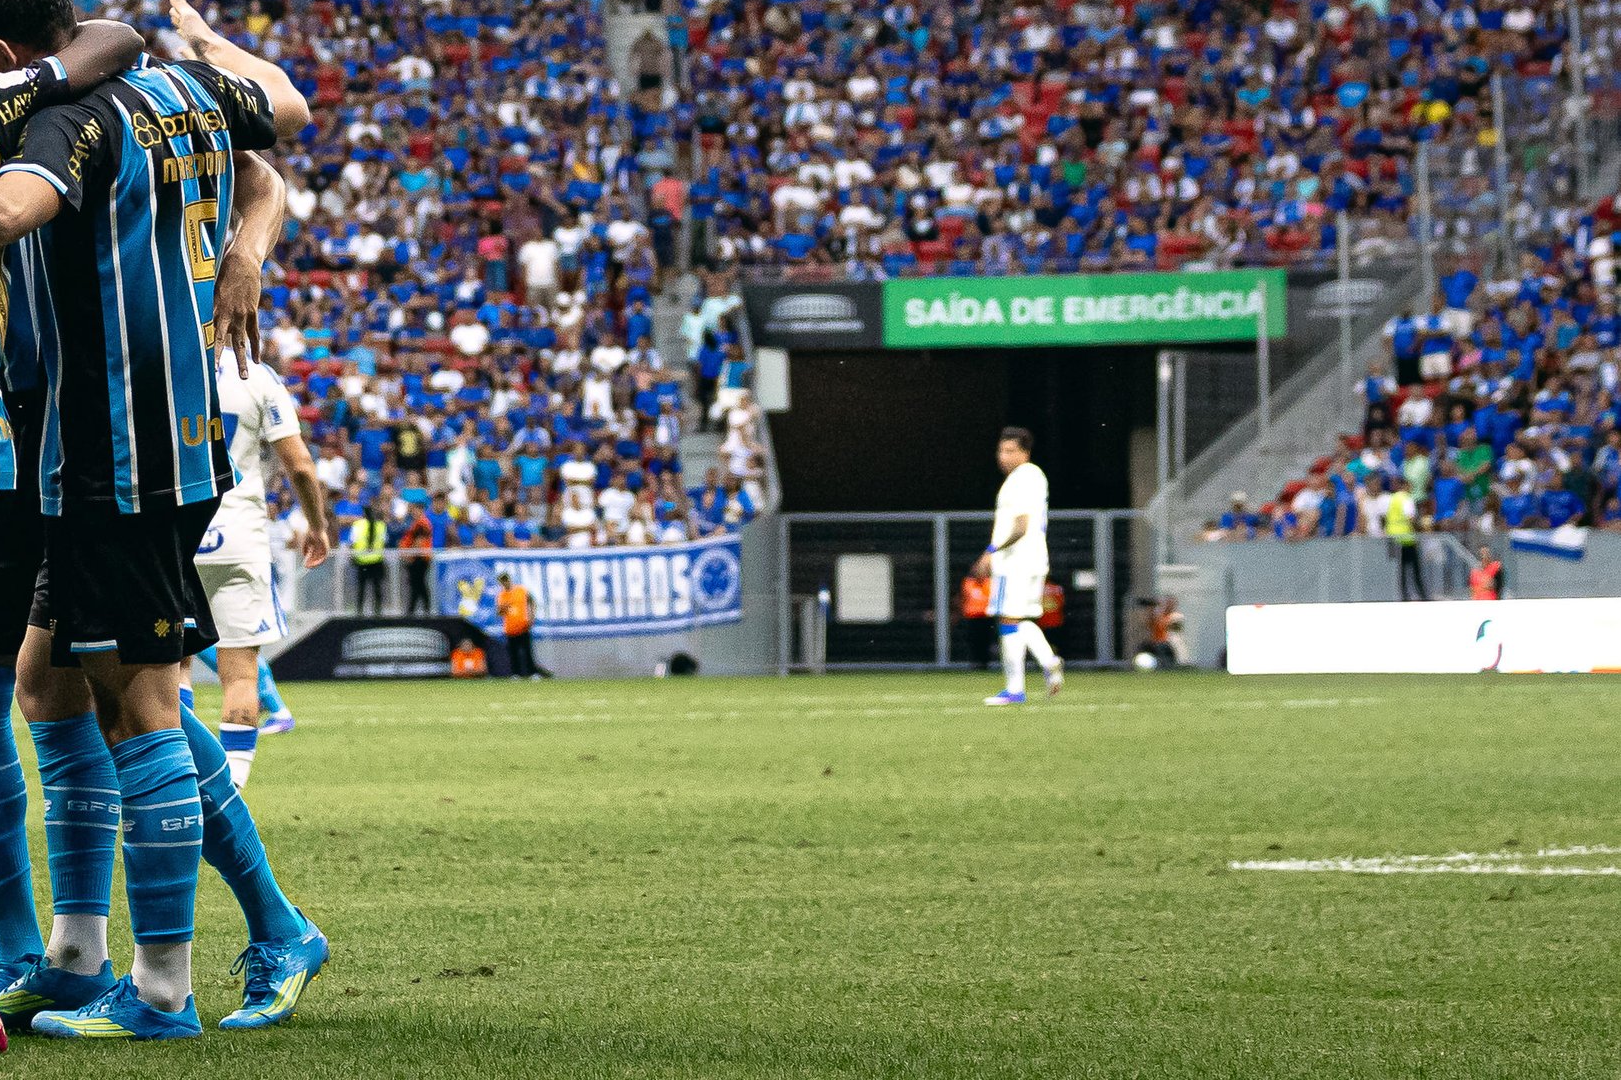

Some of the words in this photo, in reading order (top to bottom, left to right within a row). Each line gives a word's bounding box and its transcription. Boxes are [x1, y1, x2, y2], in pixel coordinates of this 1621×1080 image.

[905, 290, 1004, 328] SAÍDA
[1010, 297, 1056, 325] DE
[1063, 286, 1264, 325] EMERGÊNCIA
